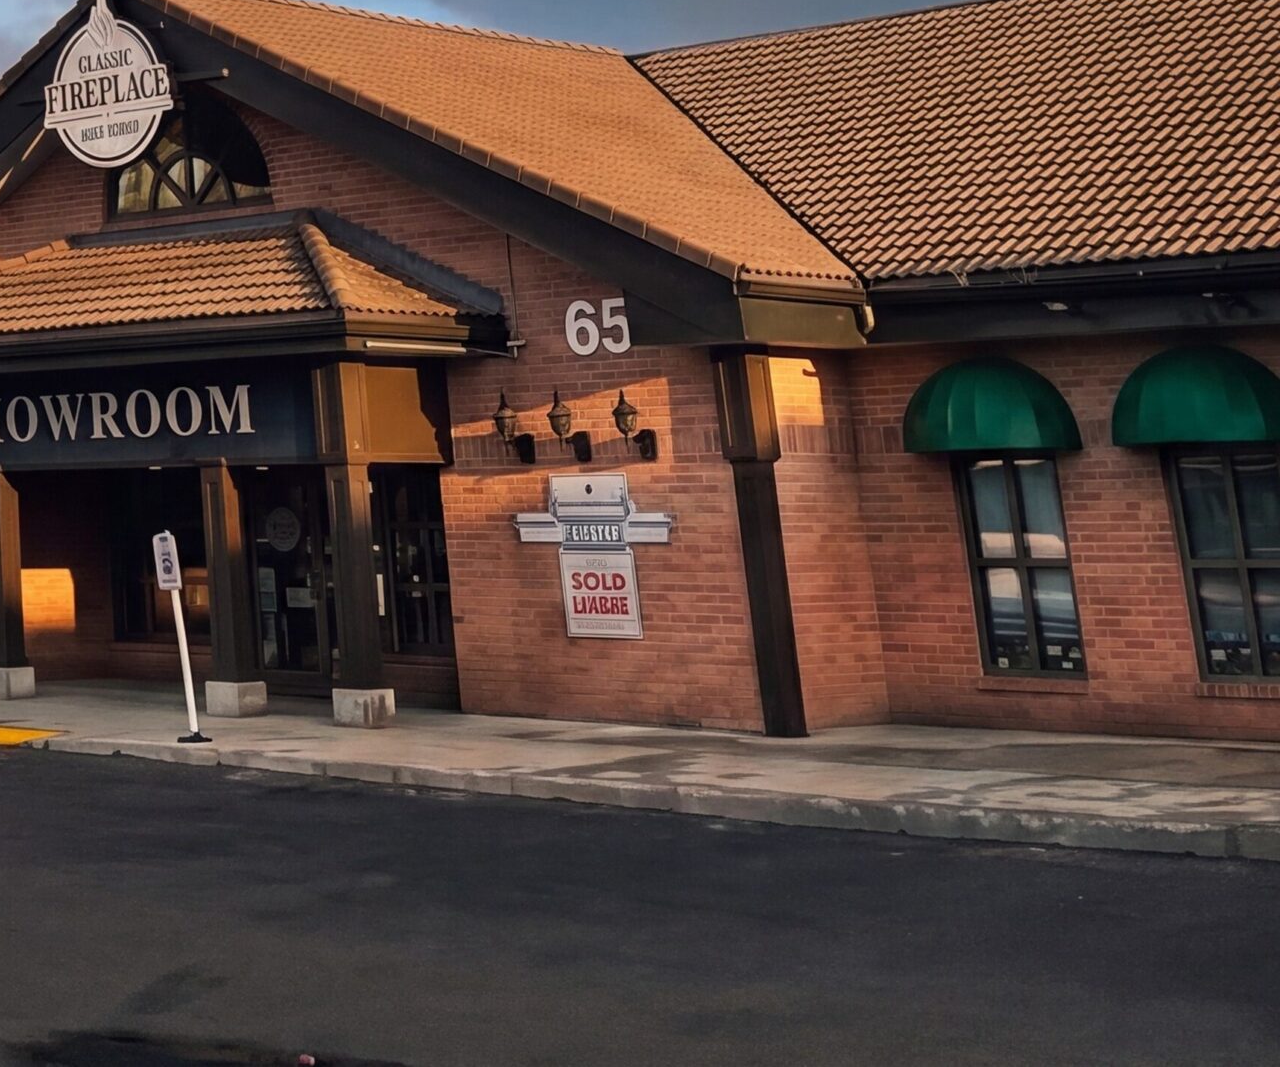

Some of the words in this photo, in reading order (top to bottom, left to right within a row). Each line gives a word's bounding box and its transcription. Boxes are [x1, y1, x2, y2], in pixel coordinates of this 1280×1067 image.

[47, 67, 168, 114] FIREPLACE
[565, 297, 631, 356] 65
[571, 572, 626, 591] SOLD
